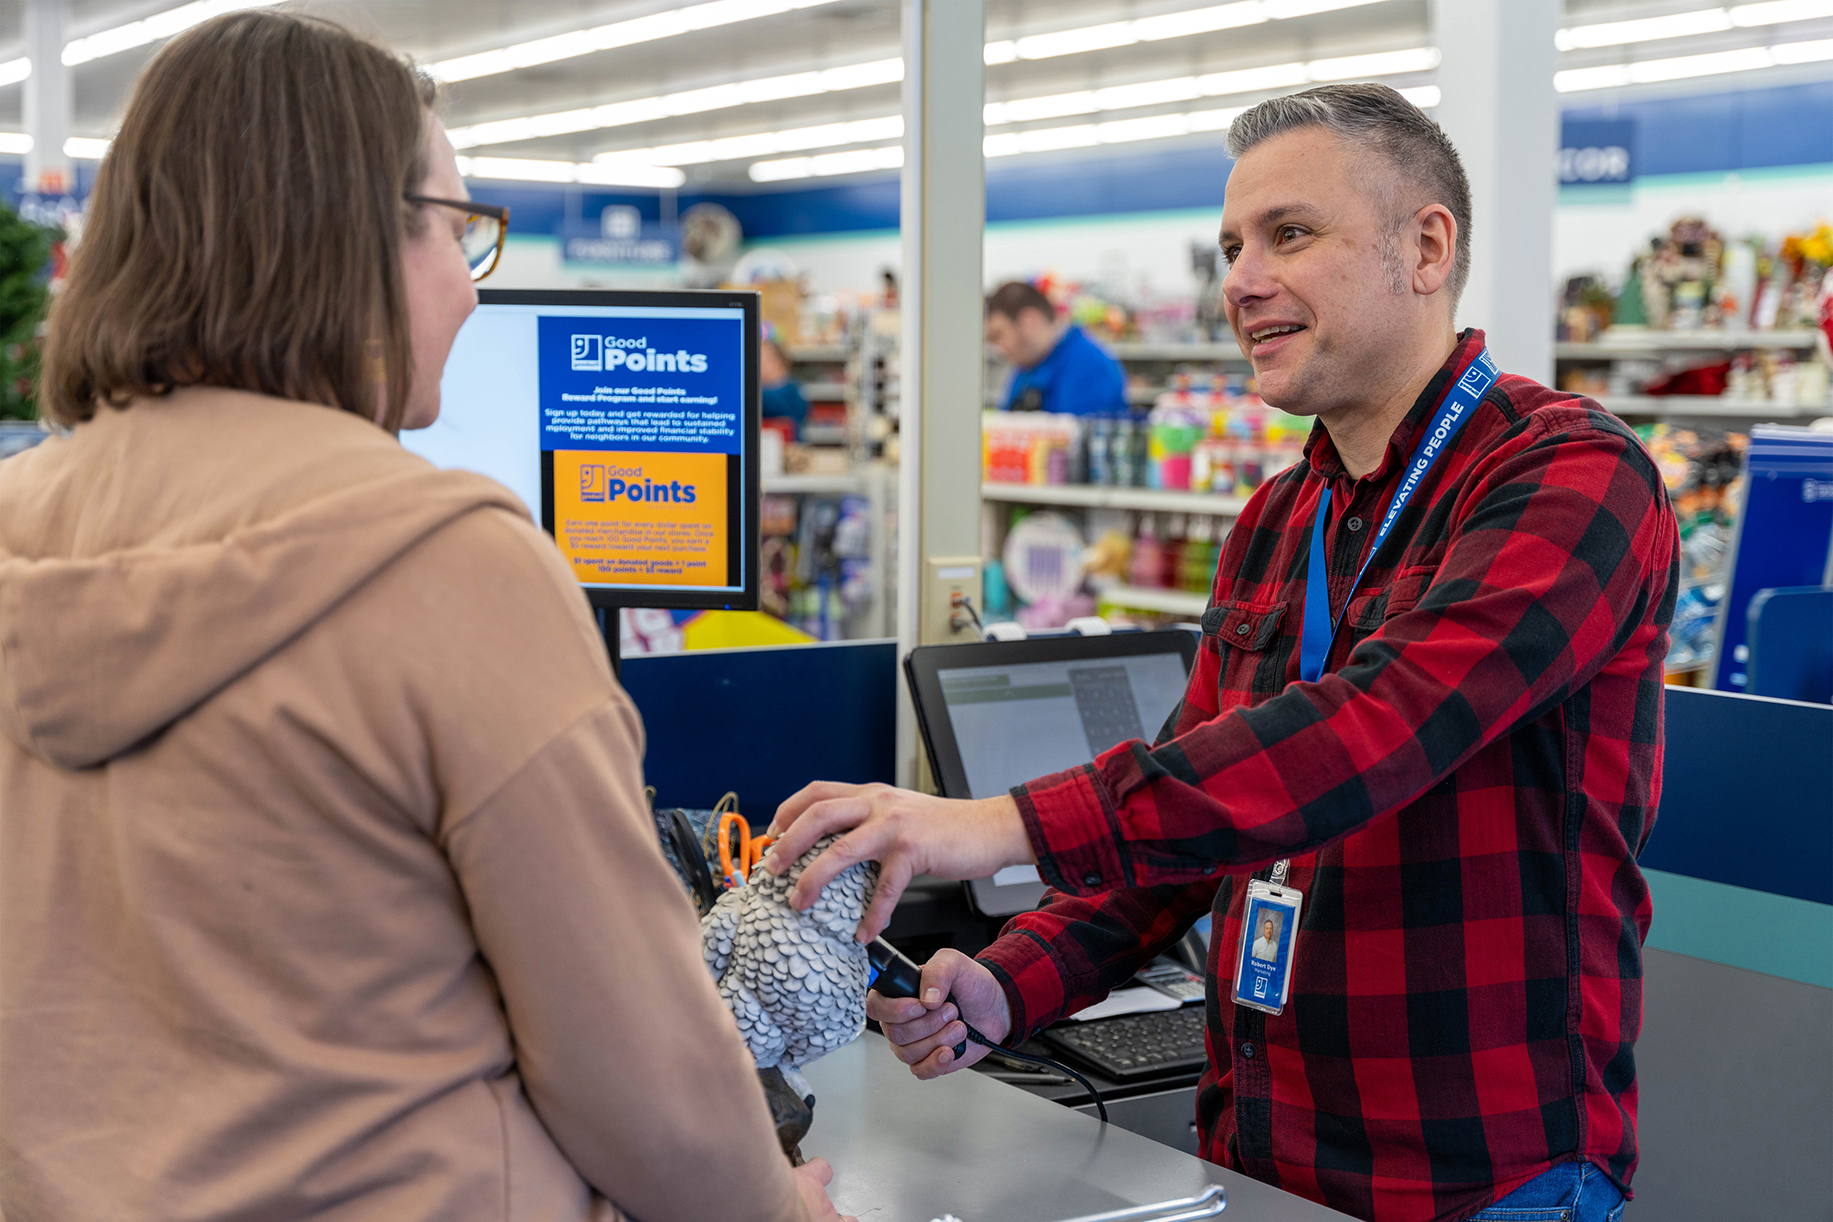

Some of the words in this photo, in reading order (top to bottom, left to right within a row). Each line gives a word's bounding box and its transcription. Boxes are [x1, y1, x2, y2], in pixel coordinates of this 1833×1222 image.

[604, 335, 647, 349] Good
[605, 348, 708, 373] Points
[593, 386, 613, 395] Join
[630, 386, 656, 395] Good
[656, 387, 687, 396] Points
[561, 393, 596, 402] Reward
[596, 394, 637, 404] Program
[637, 395, 656, 404] and
[656, 395, 679, 404] start
[679, 395, 719, 406] earning!
[544, 408, 565, 417] Sign
[566, 410, 579, 418] up
[580, 409, 605, 418] today
[607, 409, 625, 418] and
[626, 410, 642, 419] get
[643, 411, 686, 419] rewarded
[686, 411, 700, 419] for
[701, 411, 736, 421] helping
[551, 417, 586, 425] provide
[587, 417, 630, 426] pathways
[630, 418, 649, 426] that
[650, 418, 671, 427] lead
[671, 419, 683, 427] to
[683, 419, 727, 428] sustained
[597, 425, 615, 433] and
[616, 425, 659, 434] improved
[659, 426, 698, 435] financial
[698, 427, 736, 437] stability
[570, 432, 584, 440] for
[584, 433, 630, 442] neighbors
[630, 433, 640, 441] in
[641, 434, 657, 442] our
[658, 435, 711, 444] community.
[607, 465, 642, 477] Good
[1379, 458, 1428, 537] ELEVATING
[1423, 401, 1465, 458] PEOPLE
[608, 478, 696, 503] Points
[565, 518, 583, 526] Earn
[600, 520, 619, 528] point
[680, 522, 700, 530] spent
[694, 530, 714, 538] Once
[583, 558, 604, 566] spent
[617, 558, 648, 566] donated
[650, 559, 674, 568] goods
[686, 560, 707, 568] point
[597, 565, 612, 573] 100
[613, 567, 638, 575] points
[656, 567, 683, 575] reward
[1251, 960, 1267, 969] Robert
[1267, 964, 1276, 972] Dye
